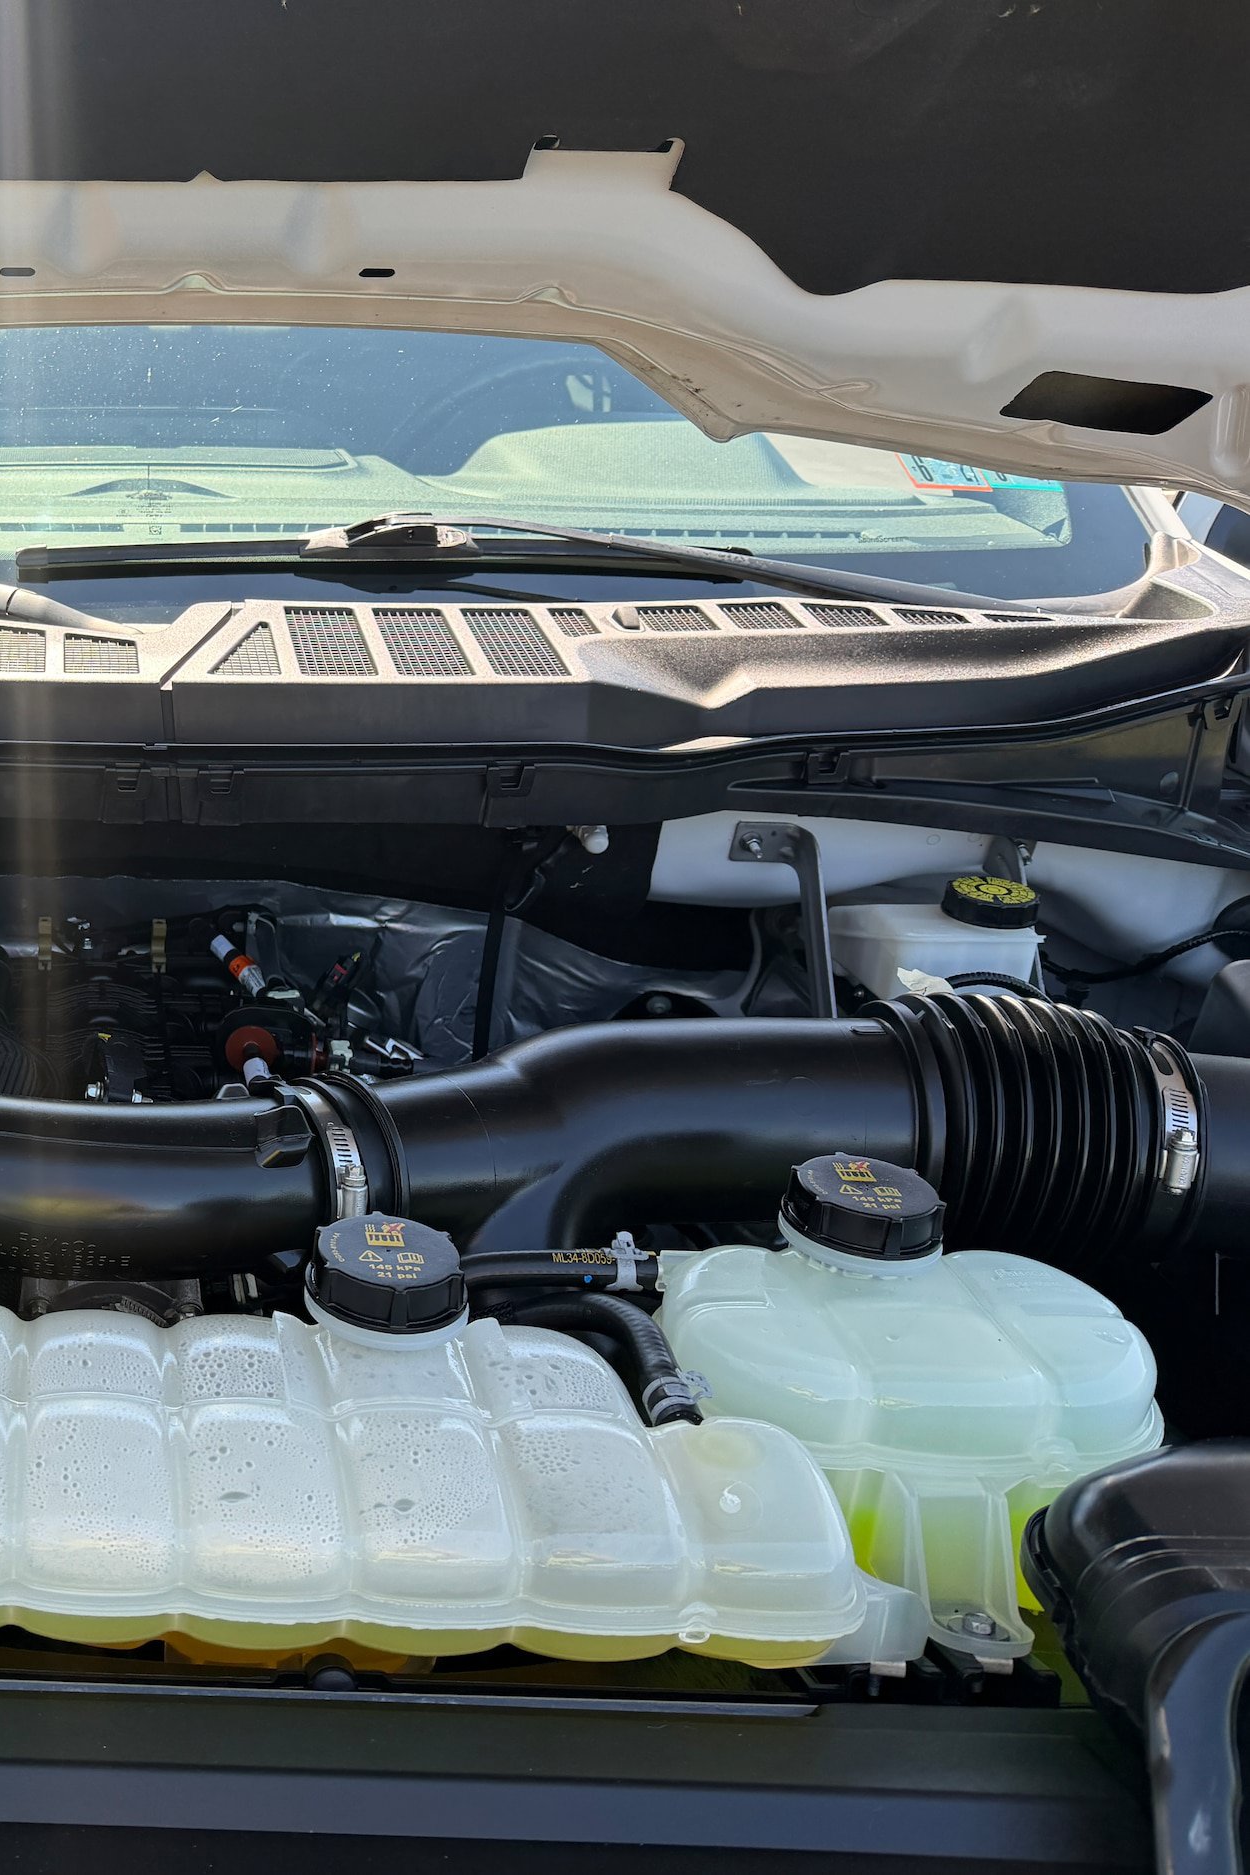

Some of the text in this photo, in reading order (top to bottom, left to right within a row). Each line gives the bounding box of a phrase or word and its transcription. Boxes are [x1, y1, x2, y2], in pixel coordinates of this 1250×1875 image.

[368, 1263, 422, 1272] 145 kPa
[377, 1271, 418, 1280] 21 psi
